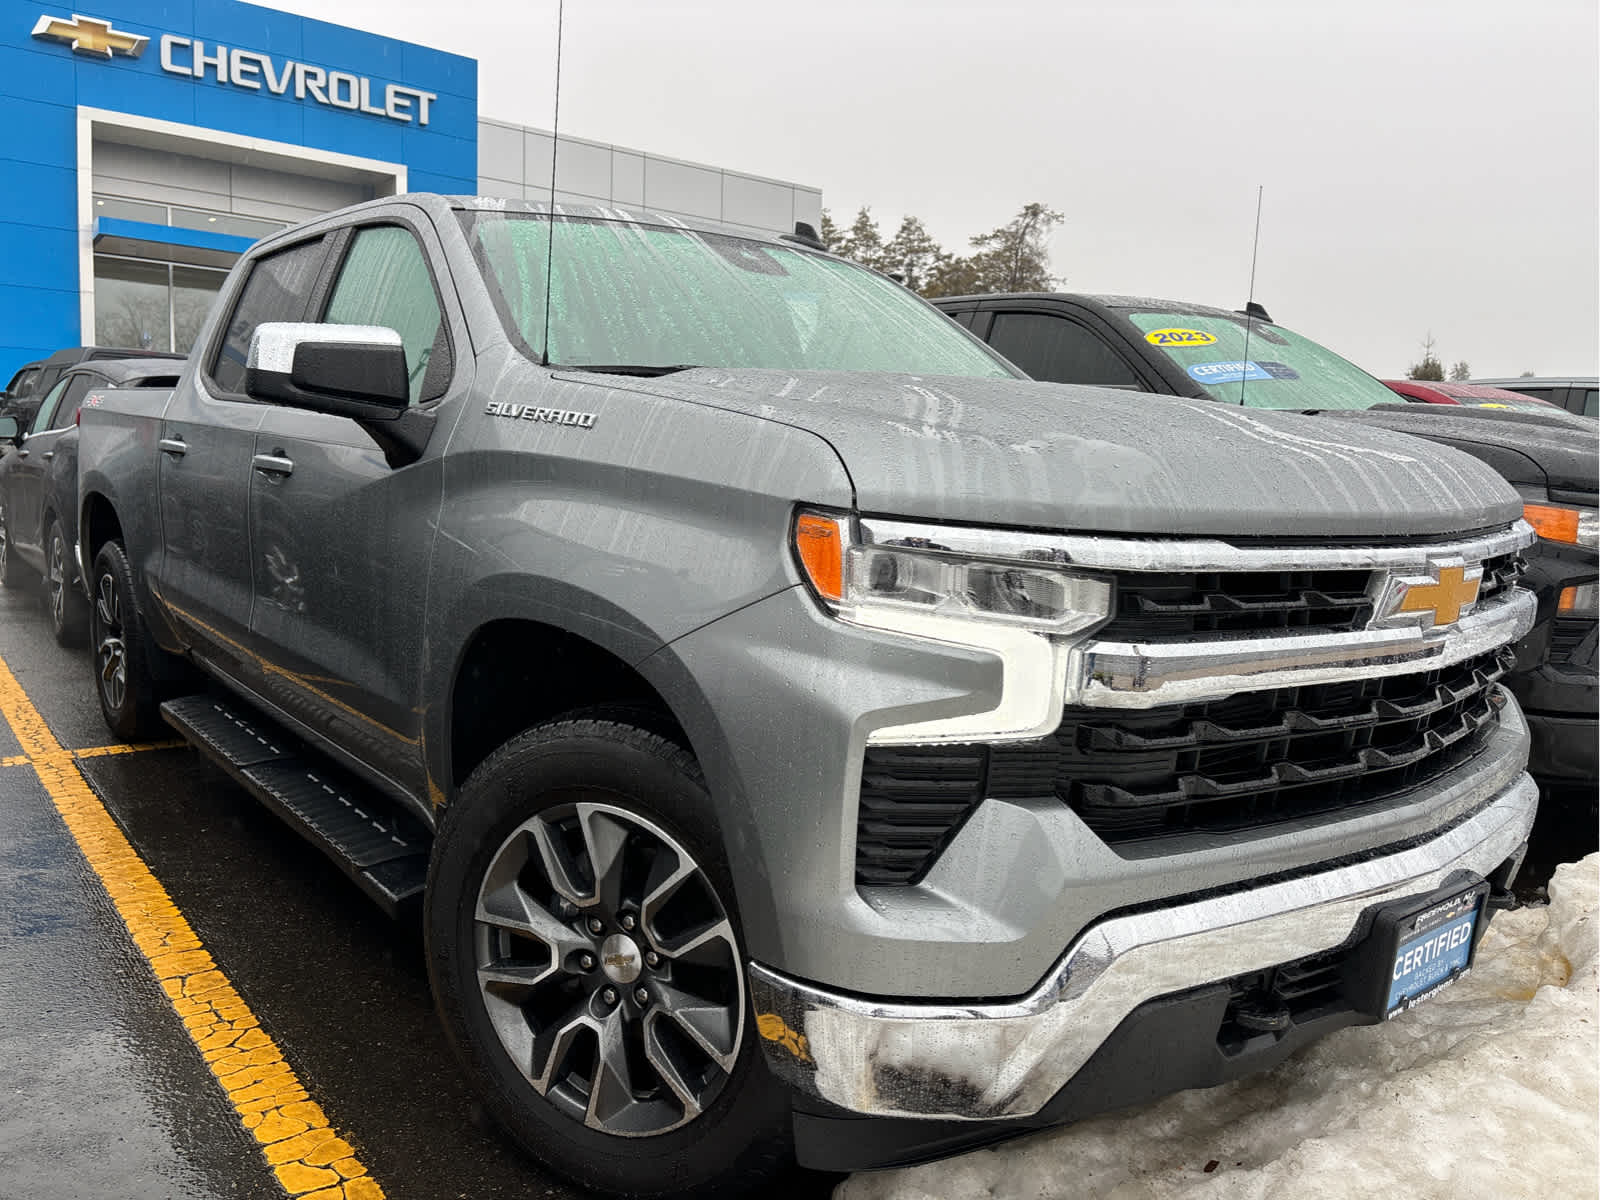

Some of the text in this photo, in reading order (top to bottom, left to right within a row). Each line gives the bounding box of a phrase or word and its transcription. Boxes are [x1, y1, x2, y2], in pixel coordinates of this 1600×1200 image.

[160, 34, 438, 126] CHEVROLET
[1153, 331, 1211, 344] 2023
[484, 401, 598, 430] SILVERADO
[1393, 922, 1471, 980] CERTIFIED
